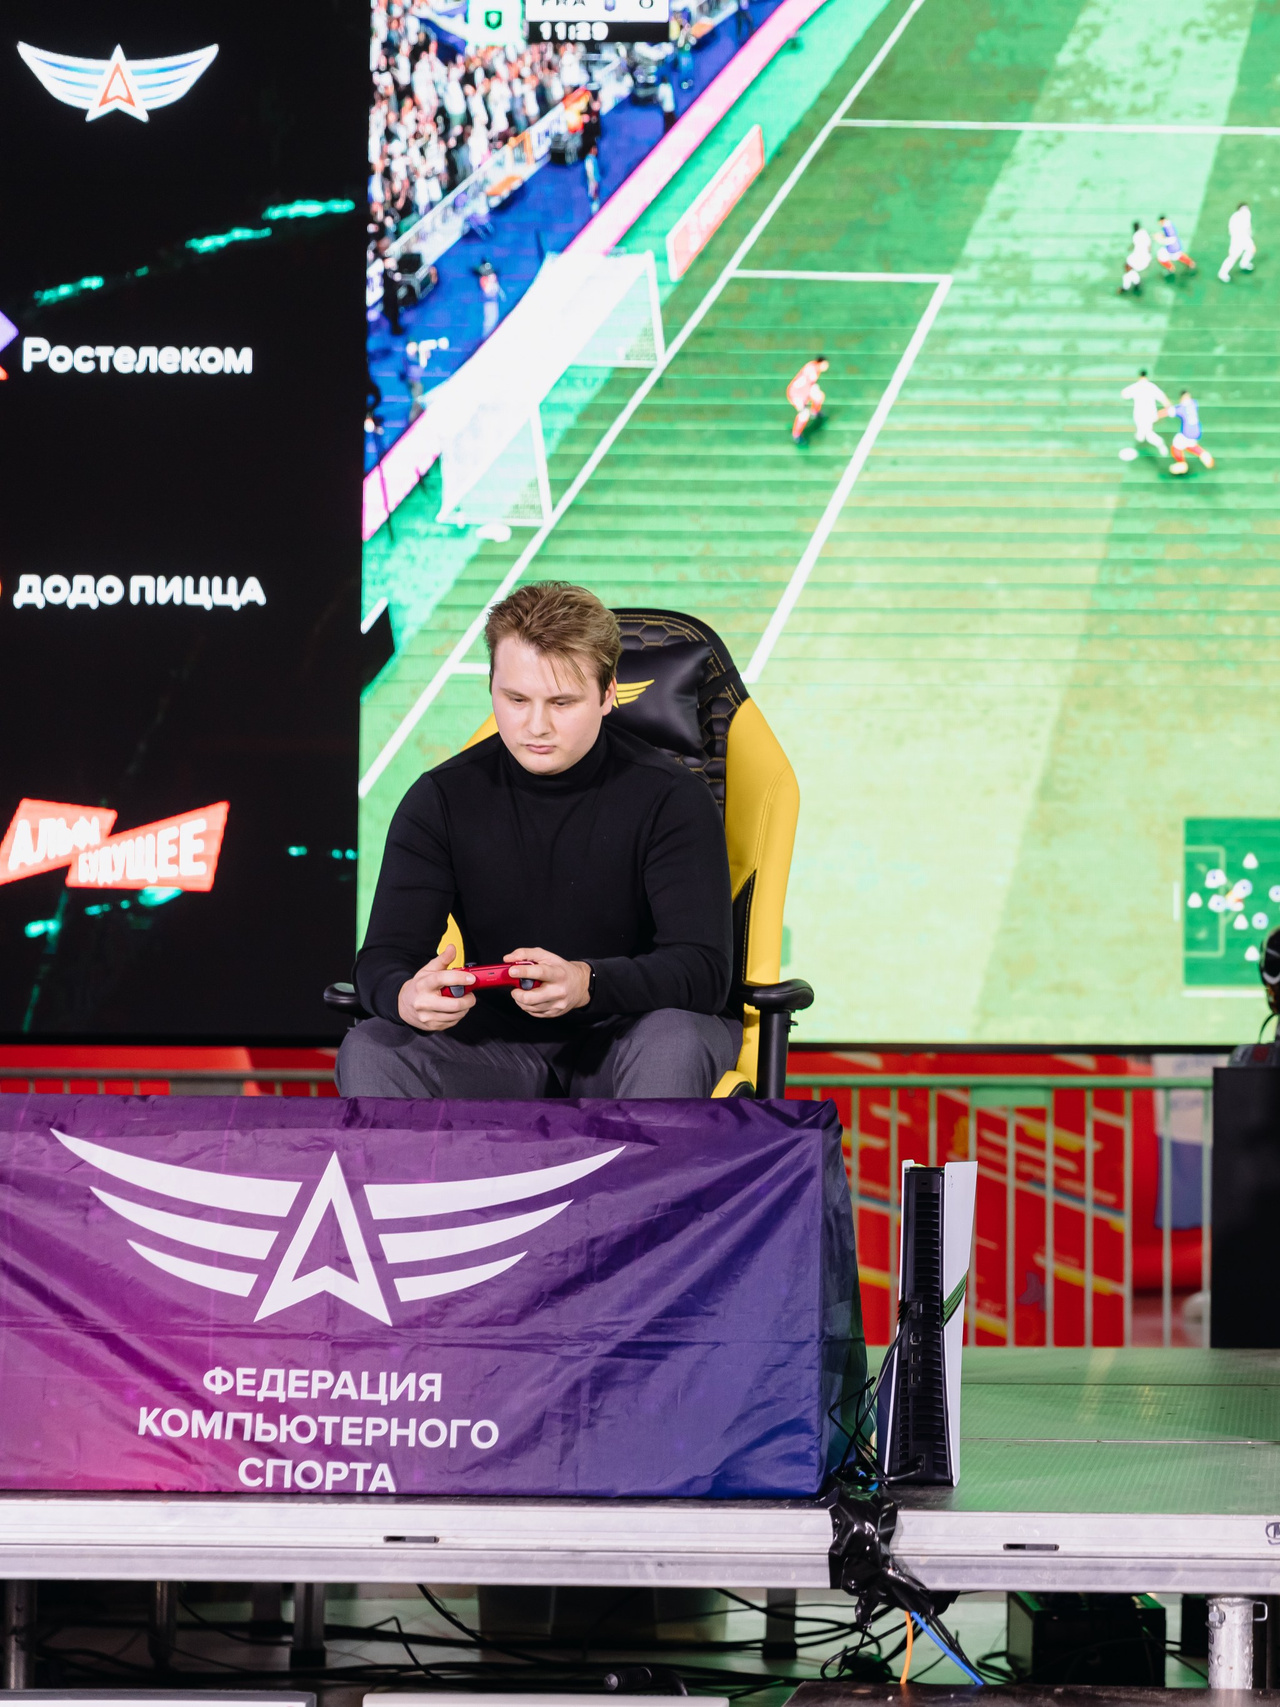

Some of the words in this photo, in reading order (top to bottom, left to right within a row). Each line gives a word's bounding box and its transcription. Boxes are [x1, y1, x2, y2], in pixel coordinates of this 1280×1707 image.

[22, 336, 253, 374] Ростелеком
[13, 574, 125, 609] ДОДО
[129, 575, 267, 611] ПИЦЦА
[203, 1366, 443, 1405] ФЕДЕРАЦИЯ
[137, 1406, 499, 1449] КОМПЬЮТЕРНОГО
[238, 1457, 397, 1493] СПОРТА
